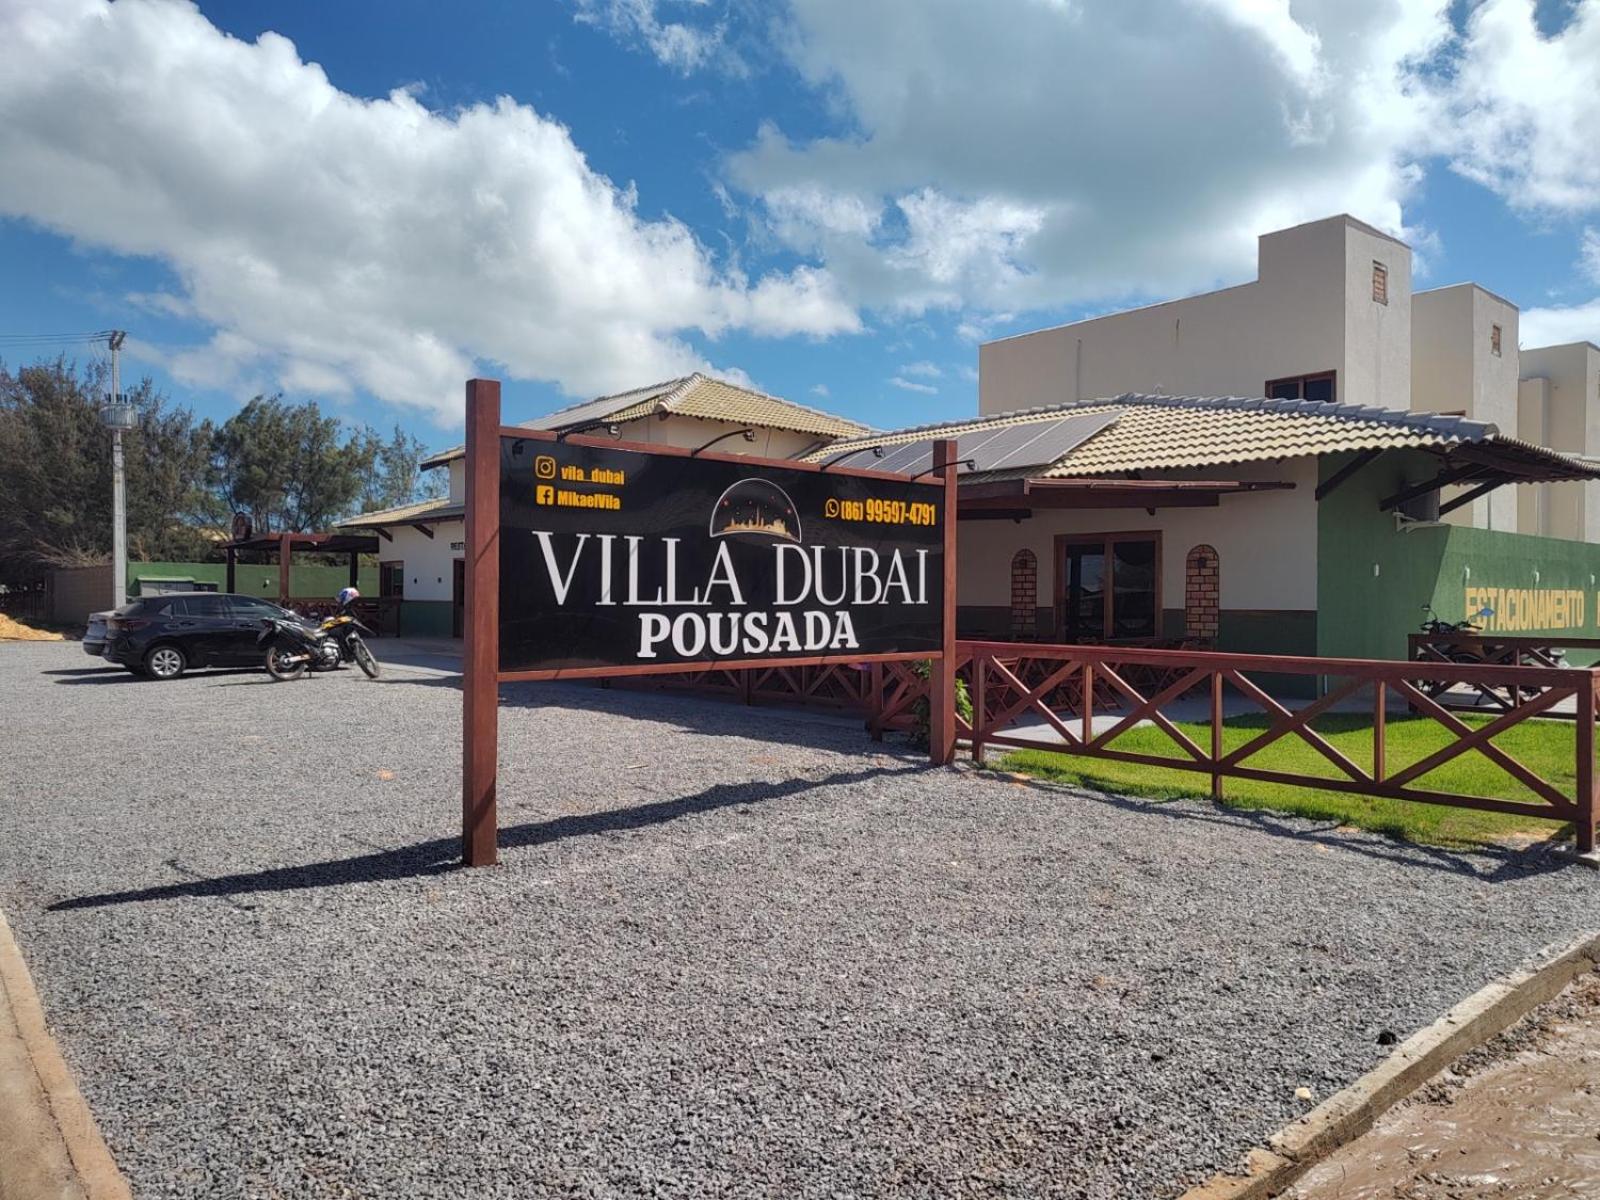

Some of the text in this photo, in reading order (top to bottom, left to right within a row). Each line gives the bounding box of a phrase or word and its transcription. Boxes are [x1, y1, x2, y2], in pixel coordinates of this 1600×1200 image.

[561, 465, 625, 485] vila_dubai
[558, 490, 621, 510] MikaelVila
[841, 498, 936, 526] (86) 99597-4791
[532, 530, 929, 606] VILLA DUBAI
[1465, 587, 1584, 632] ESTACIONAMENTO
[636, 610, 860, 658] POUSADA
